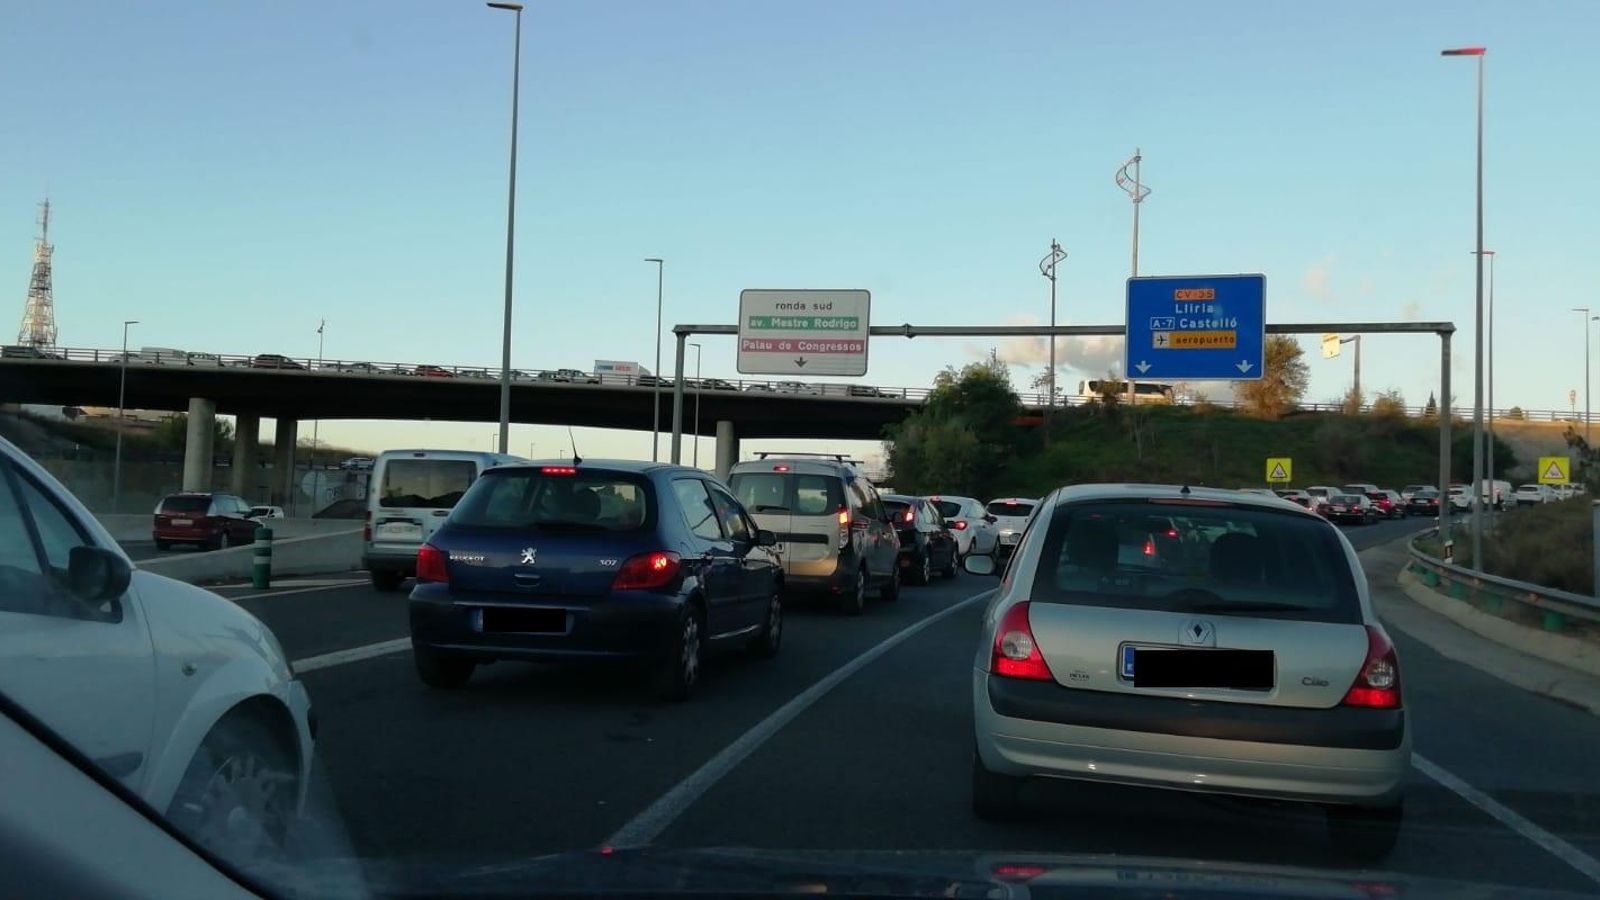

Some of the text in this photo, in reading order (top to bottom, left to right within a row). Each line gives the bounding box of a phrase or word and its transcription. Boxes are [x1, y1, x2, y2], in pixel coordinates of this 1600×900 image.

[775, 302, 833, 310] ronda sud
[750, 318, 857, 329] av. Mestre Rodrigo
[1152, 318, 1238, 329] A-7 Castelló
[1176, 335, 1235, 345] aeropuerto
[742, 340, 862, 352] Palau de Congressos
[1301, 676, 1330, 688] Clio
